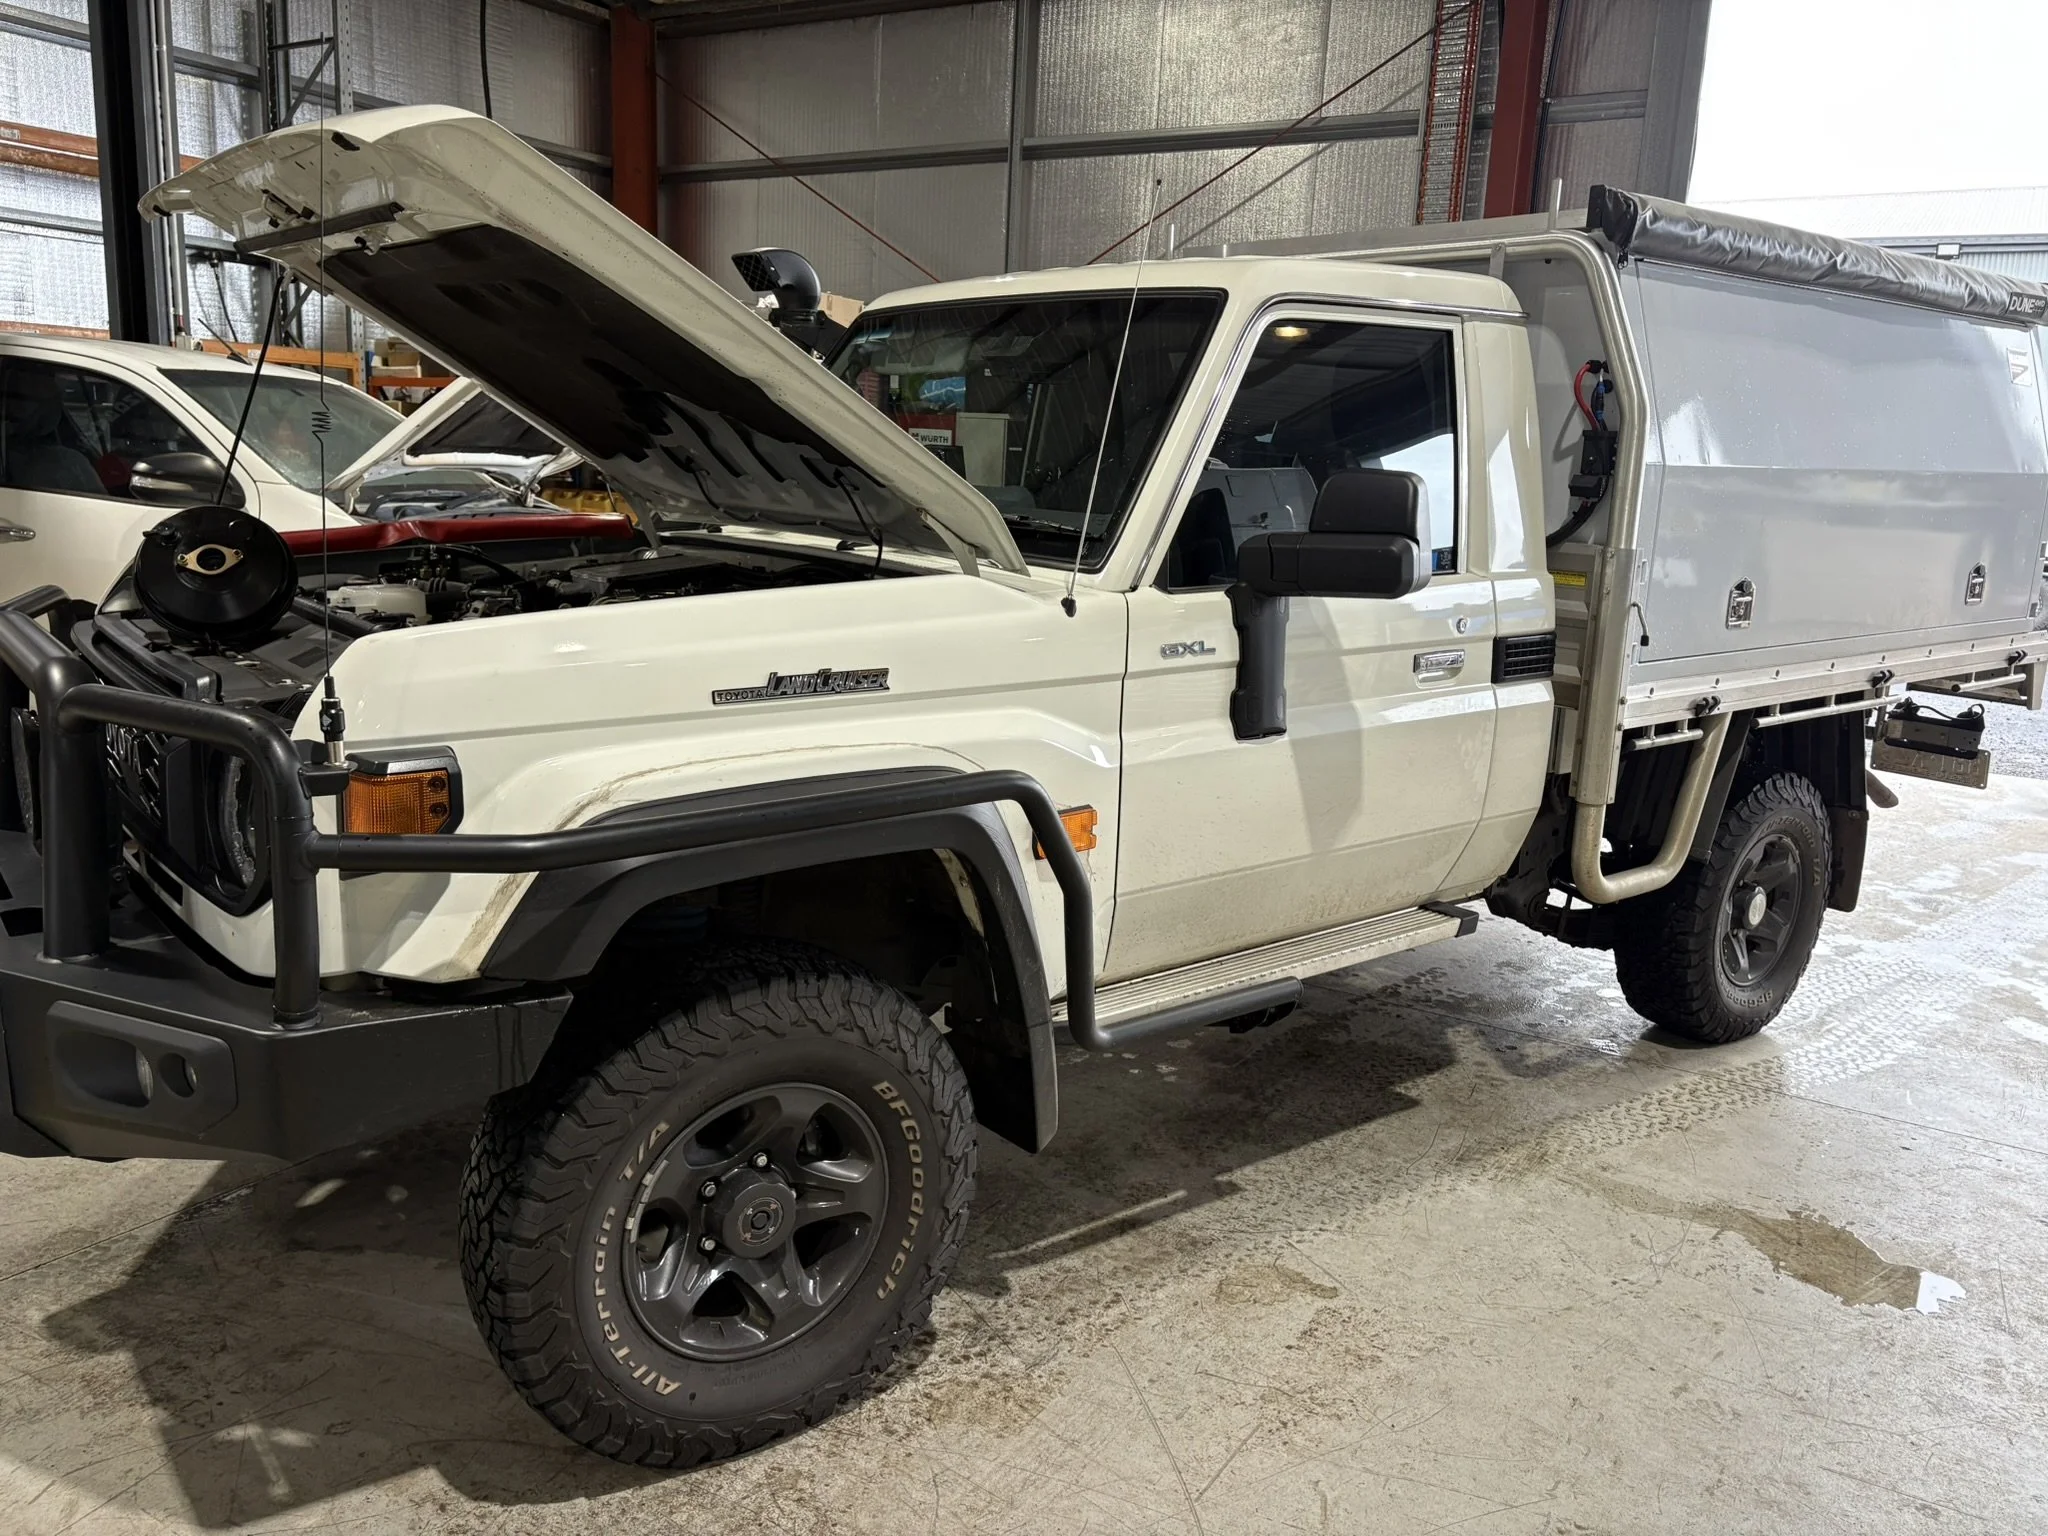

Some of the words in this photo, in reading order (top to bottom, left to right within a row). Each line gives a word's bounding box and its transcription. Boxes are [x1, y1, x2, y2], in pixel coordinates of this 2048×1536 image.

[2010, 295, 2035, 313] DUNE
[1160, 640, 1217, 659] GXL
[716, 690, 765, 702] TOYOTA
[618, 1121, 670, 1181] T/A
[872, 1080, 925, 1300] BFGoodrich
[594, 1206, 682, 1396] All-Terrain
